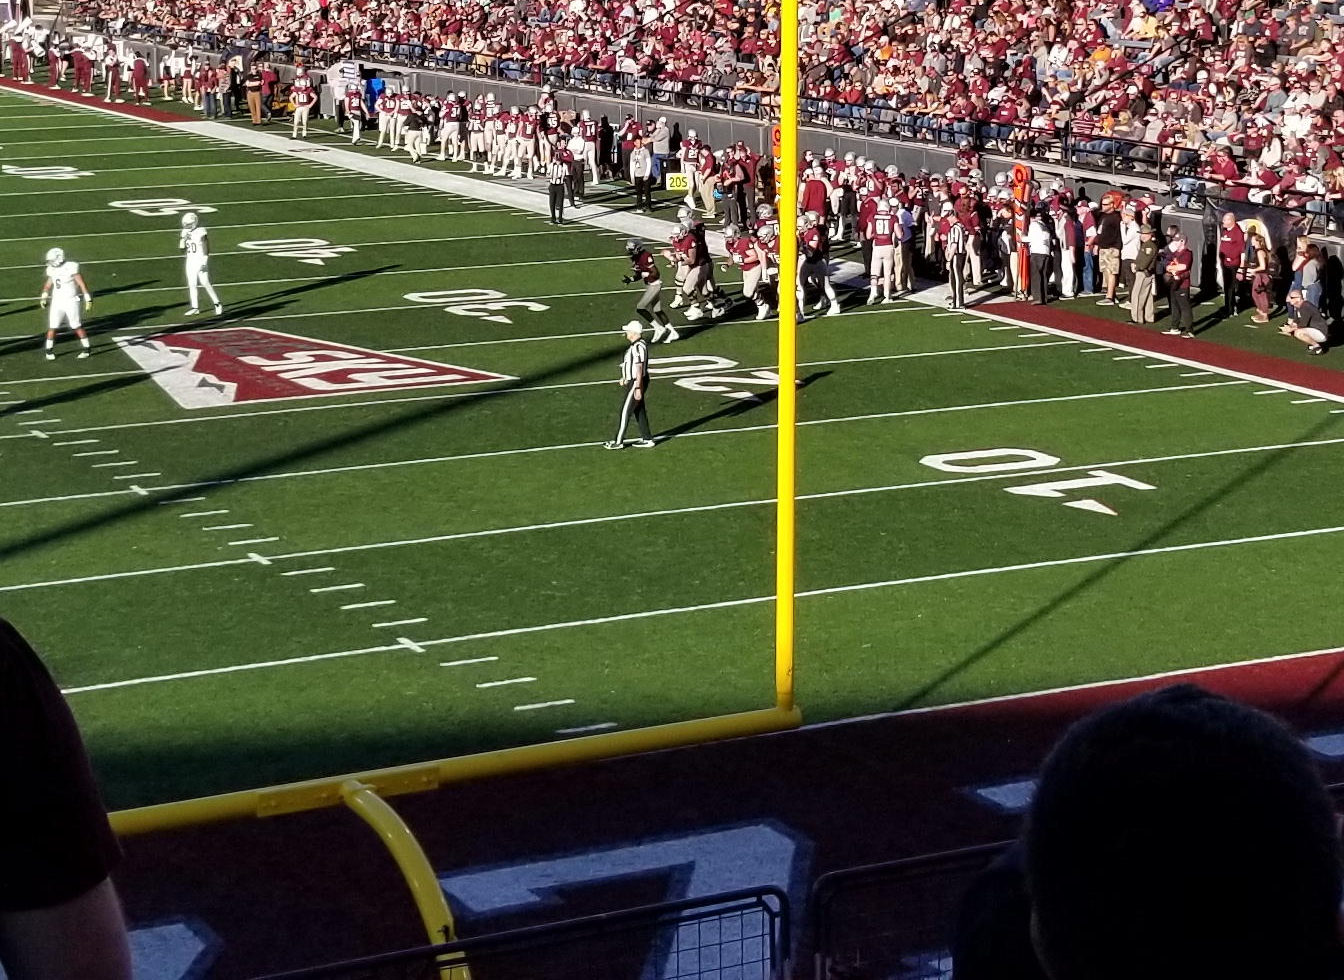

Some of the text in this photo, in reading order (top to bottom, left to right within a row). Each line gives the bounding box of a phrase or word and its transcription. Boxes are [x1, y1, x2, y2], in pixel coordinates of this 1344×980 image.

[237, 238, 358, 259] 40
[403, 288, 552, 318] 30
[919, 448, 1157, 498] 10
